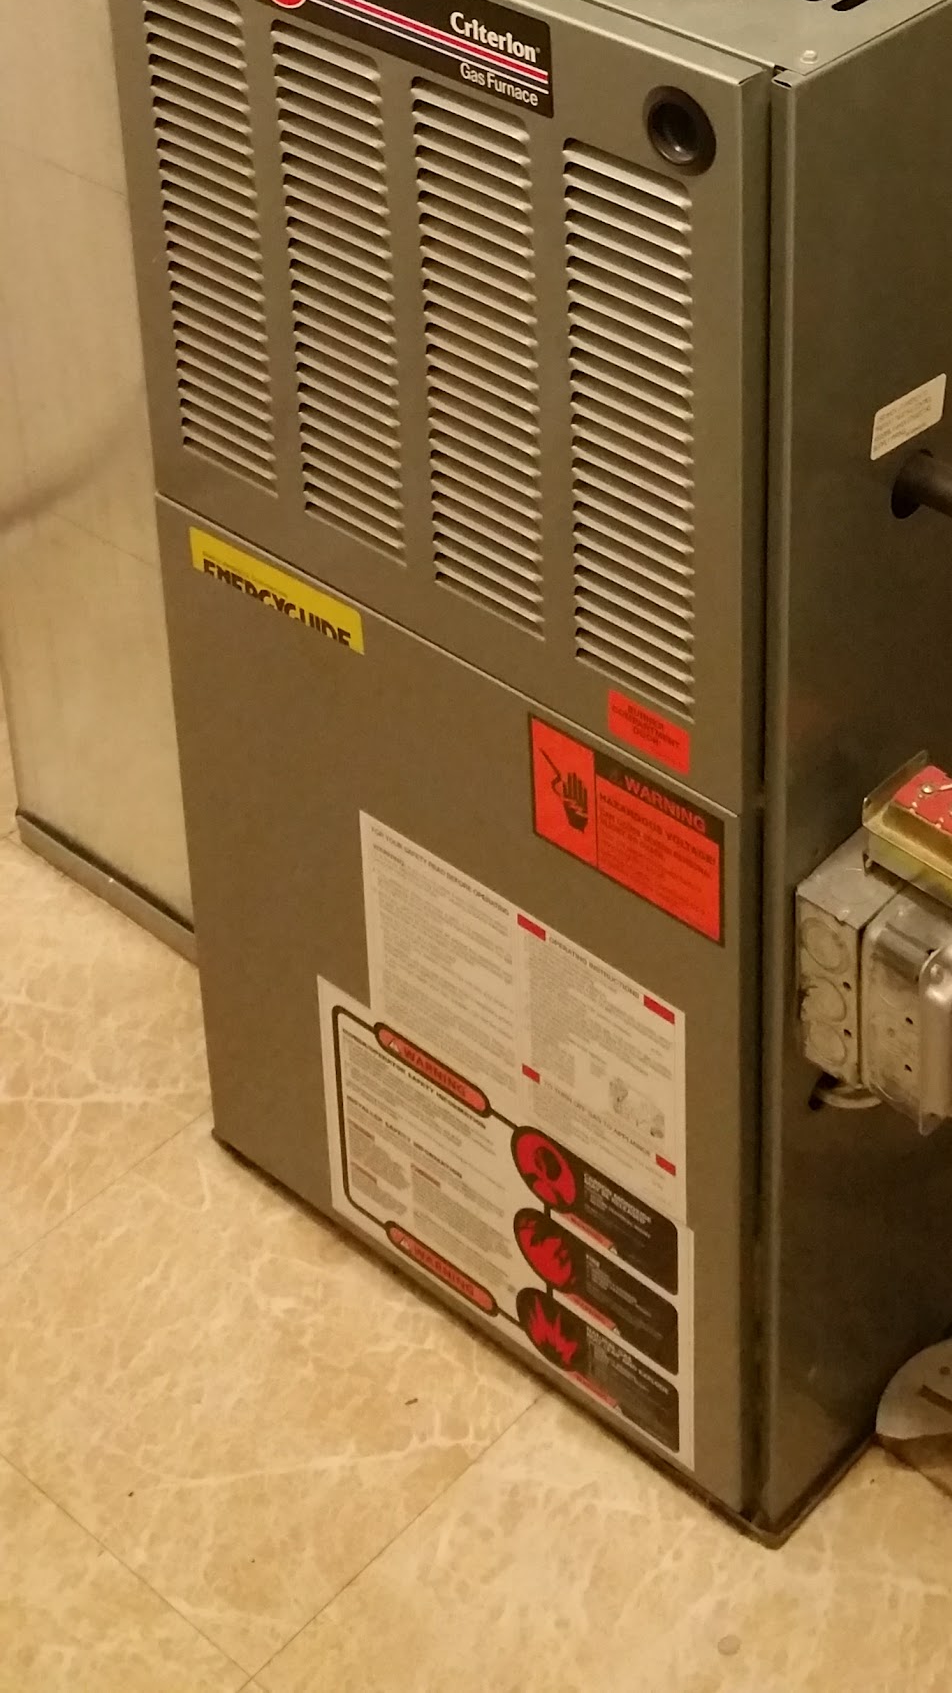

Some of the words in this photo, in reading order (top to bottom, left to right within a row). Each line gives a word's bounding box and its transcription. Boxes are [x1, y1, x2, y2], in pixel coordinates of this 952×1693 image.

[460, 61, 486, 87] Gas
[486, 71, 539, 107] Furnace
[624, 774, 707, 833] WARNING
[404, 1044, 468, 1099] WARNING
